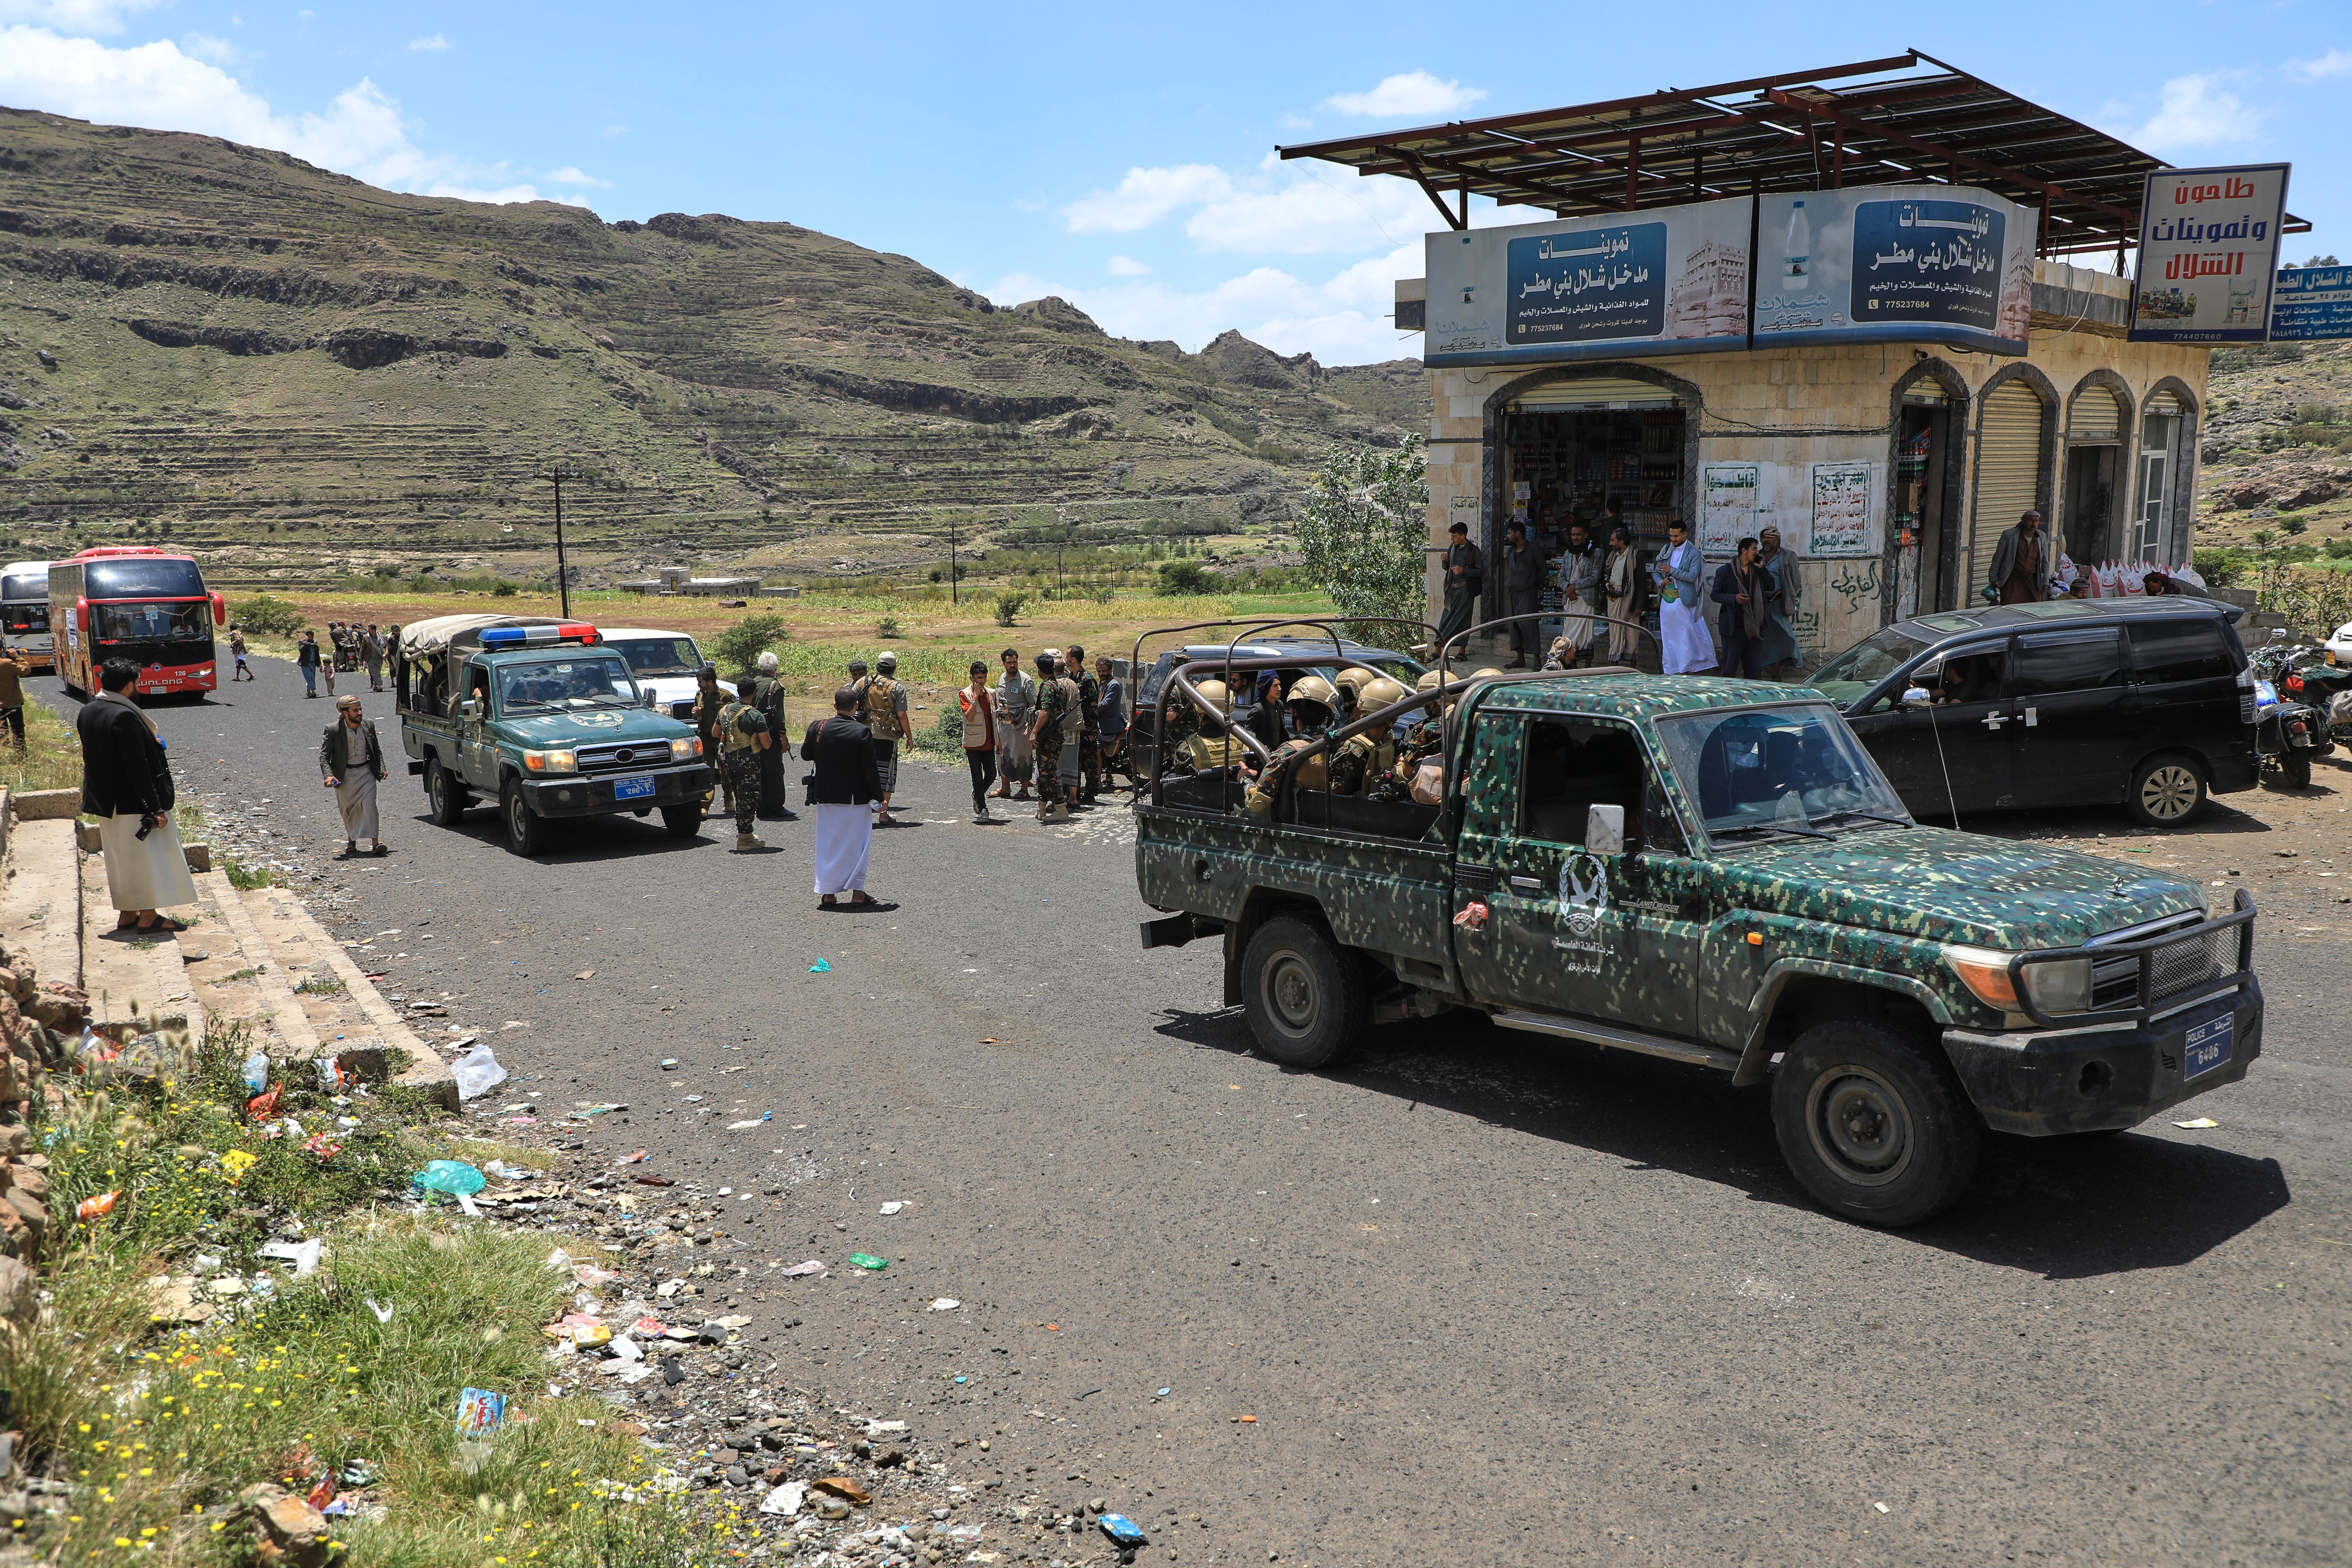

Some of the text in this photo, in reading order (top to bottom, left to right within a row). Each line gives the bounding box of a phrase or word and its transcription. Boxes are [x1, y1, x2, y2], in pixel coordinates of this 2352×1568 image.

[2175, 177, 2254, 205] طاحون
[1899, 204, 1989, 239] تموينات
[2152, 215, 2267, 243] وتموينات
[1539, 230, 1629, 260] تموينات
[1869, 241, 1994, 274] مدخل شلال بني مطر
[2165, 252, 2244, 280] الشلال
[1519, 263, 1649, 299] مدخل شلال بني مطر
[1869, 281, 1898, 292] والخيم
[1900, 281, 1940, 291] والمعسلات
[1941, 282, 1965, 293] والشيش
[2275, 273, 2303, 292] الطبي
[2306, 271, 2343, 290] الشلال
[1966, 285, 1982, 295] الغذائية
[2333, 292, 2350, 300] دوام
[1519, 299, 1649, 317] للمواد الغذائية والشيش والمعسلات والخيم
[2333, 305, 2352, 314] دلية
[1530, 324, 1563, 332] 775237684
[2310, 317, 2327, 326] طبية
[1555, 937, 1580, 949] العاصمة
[2187, 1029, 2205, 1044] POLICE
[2199, 1043, 2219, 1065] 6486
